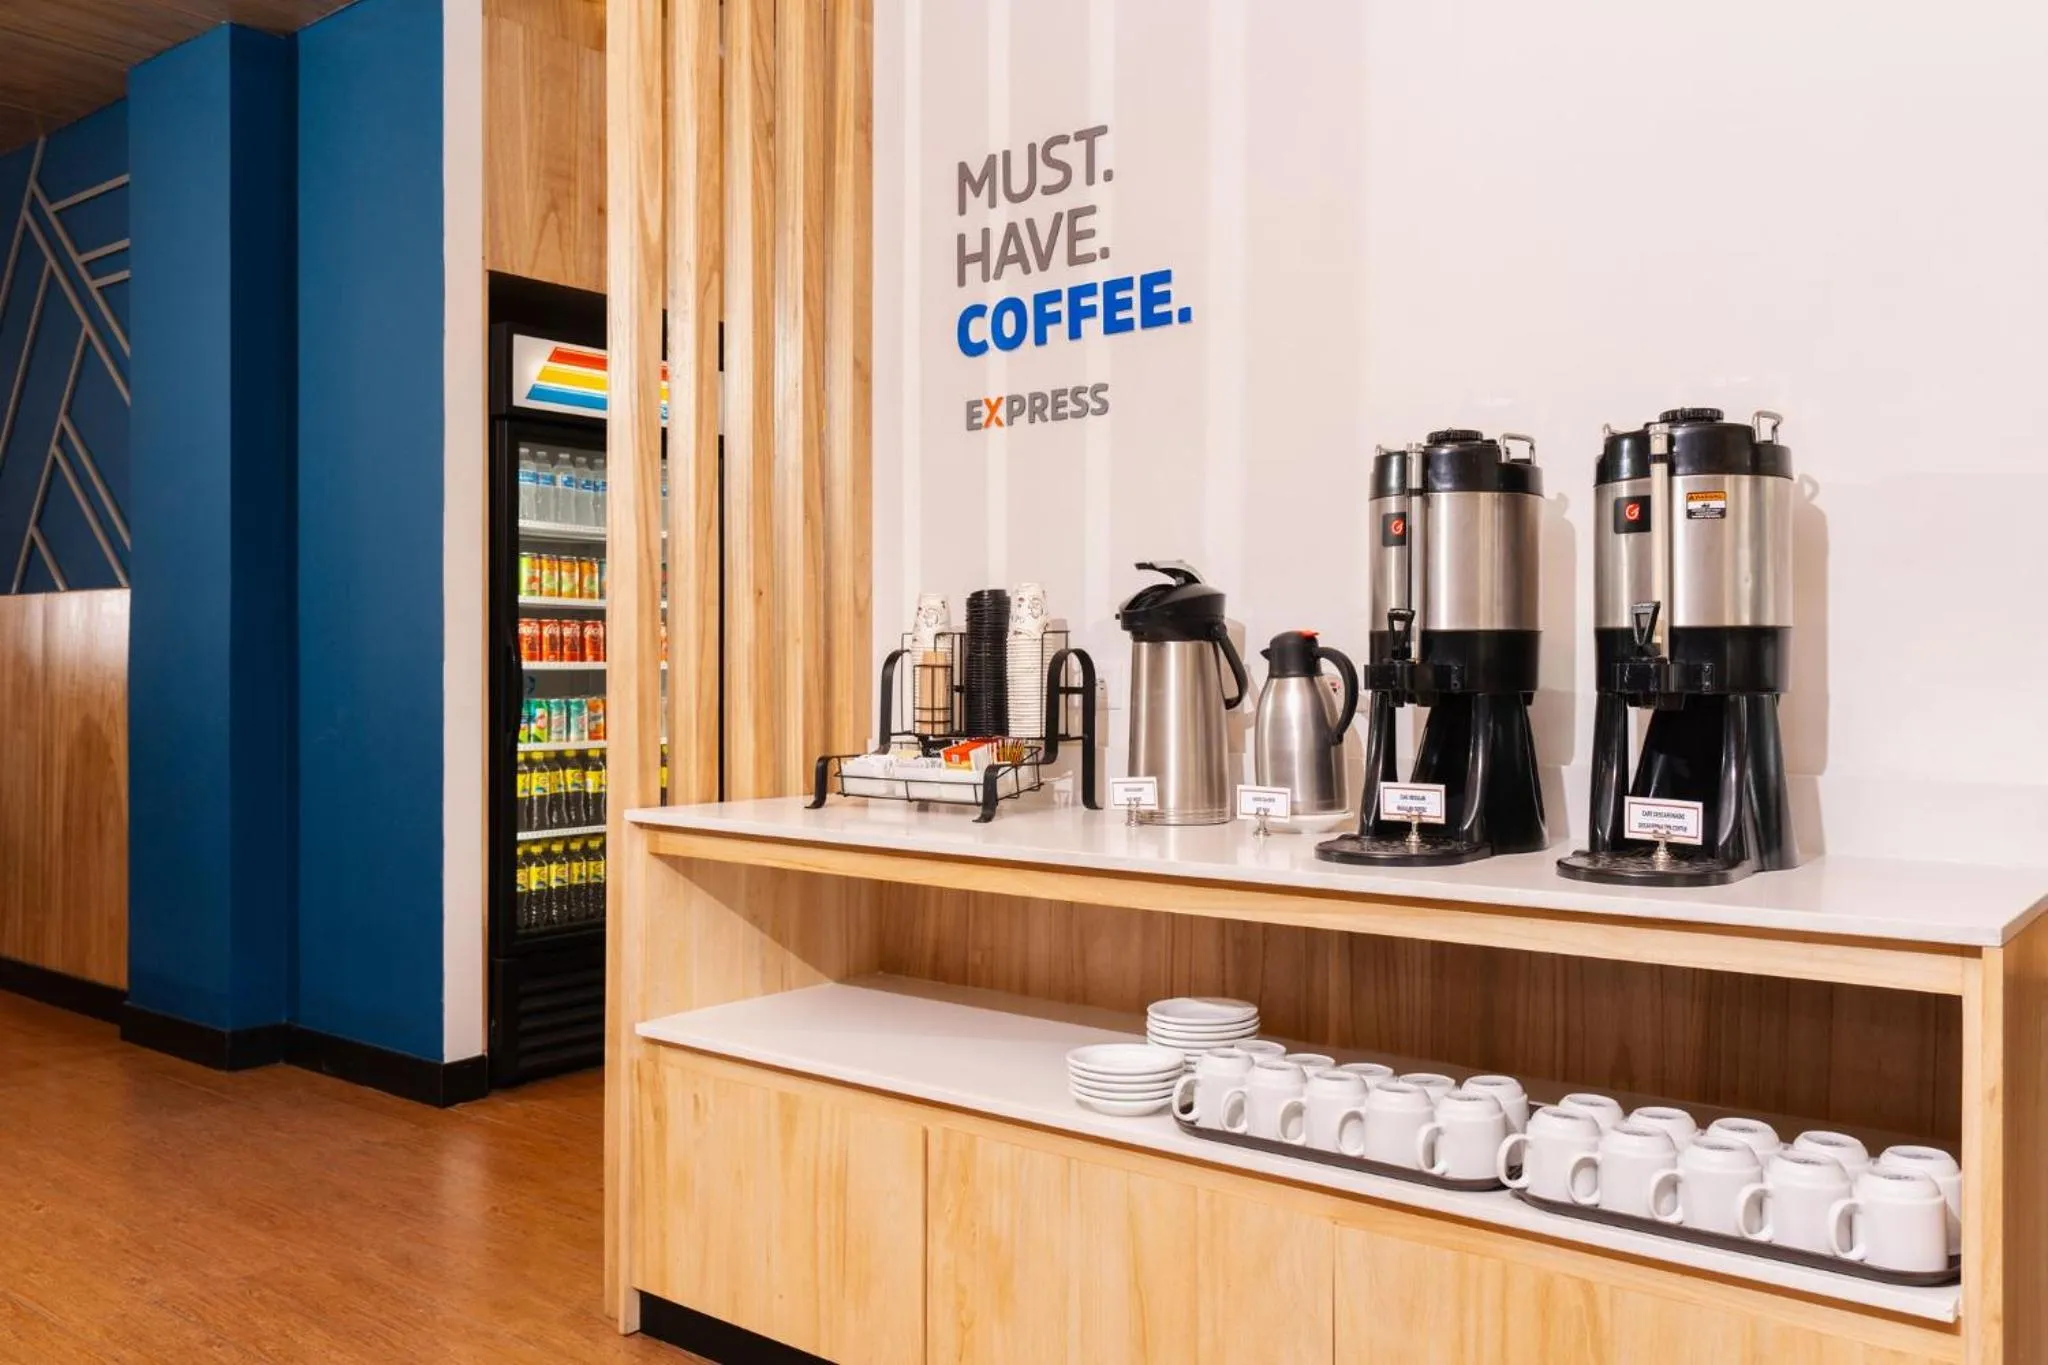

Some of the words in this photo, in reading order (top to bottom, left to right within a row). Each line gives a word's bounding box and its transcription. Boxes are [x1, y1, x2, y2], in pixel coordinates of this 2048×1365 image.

[957, 124, 1114, 217] MUST.
[956, 204, 1110, 288] HAVE.
[956, 269, 1192, 358] COFFEE.
[966, 383, 1110, 431] EXPRESS
